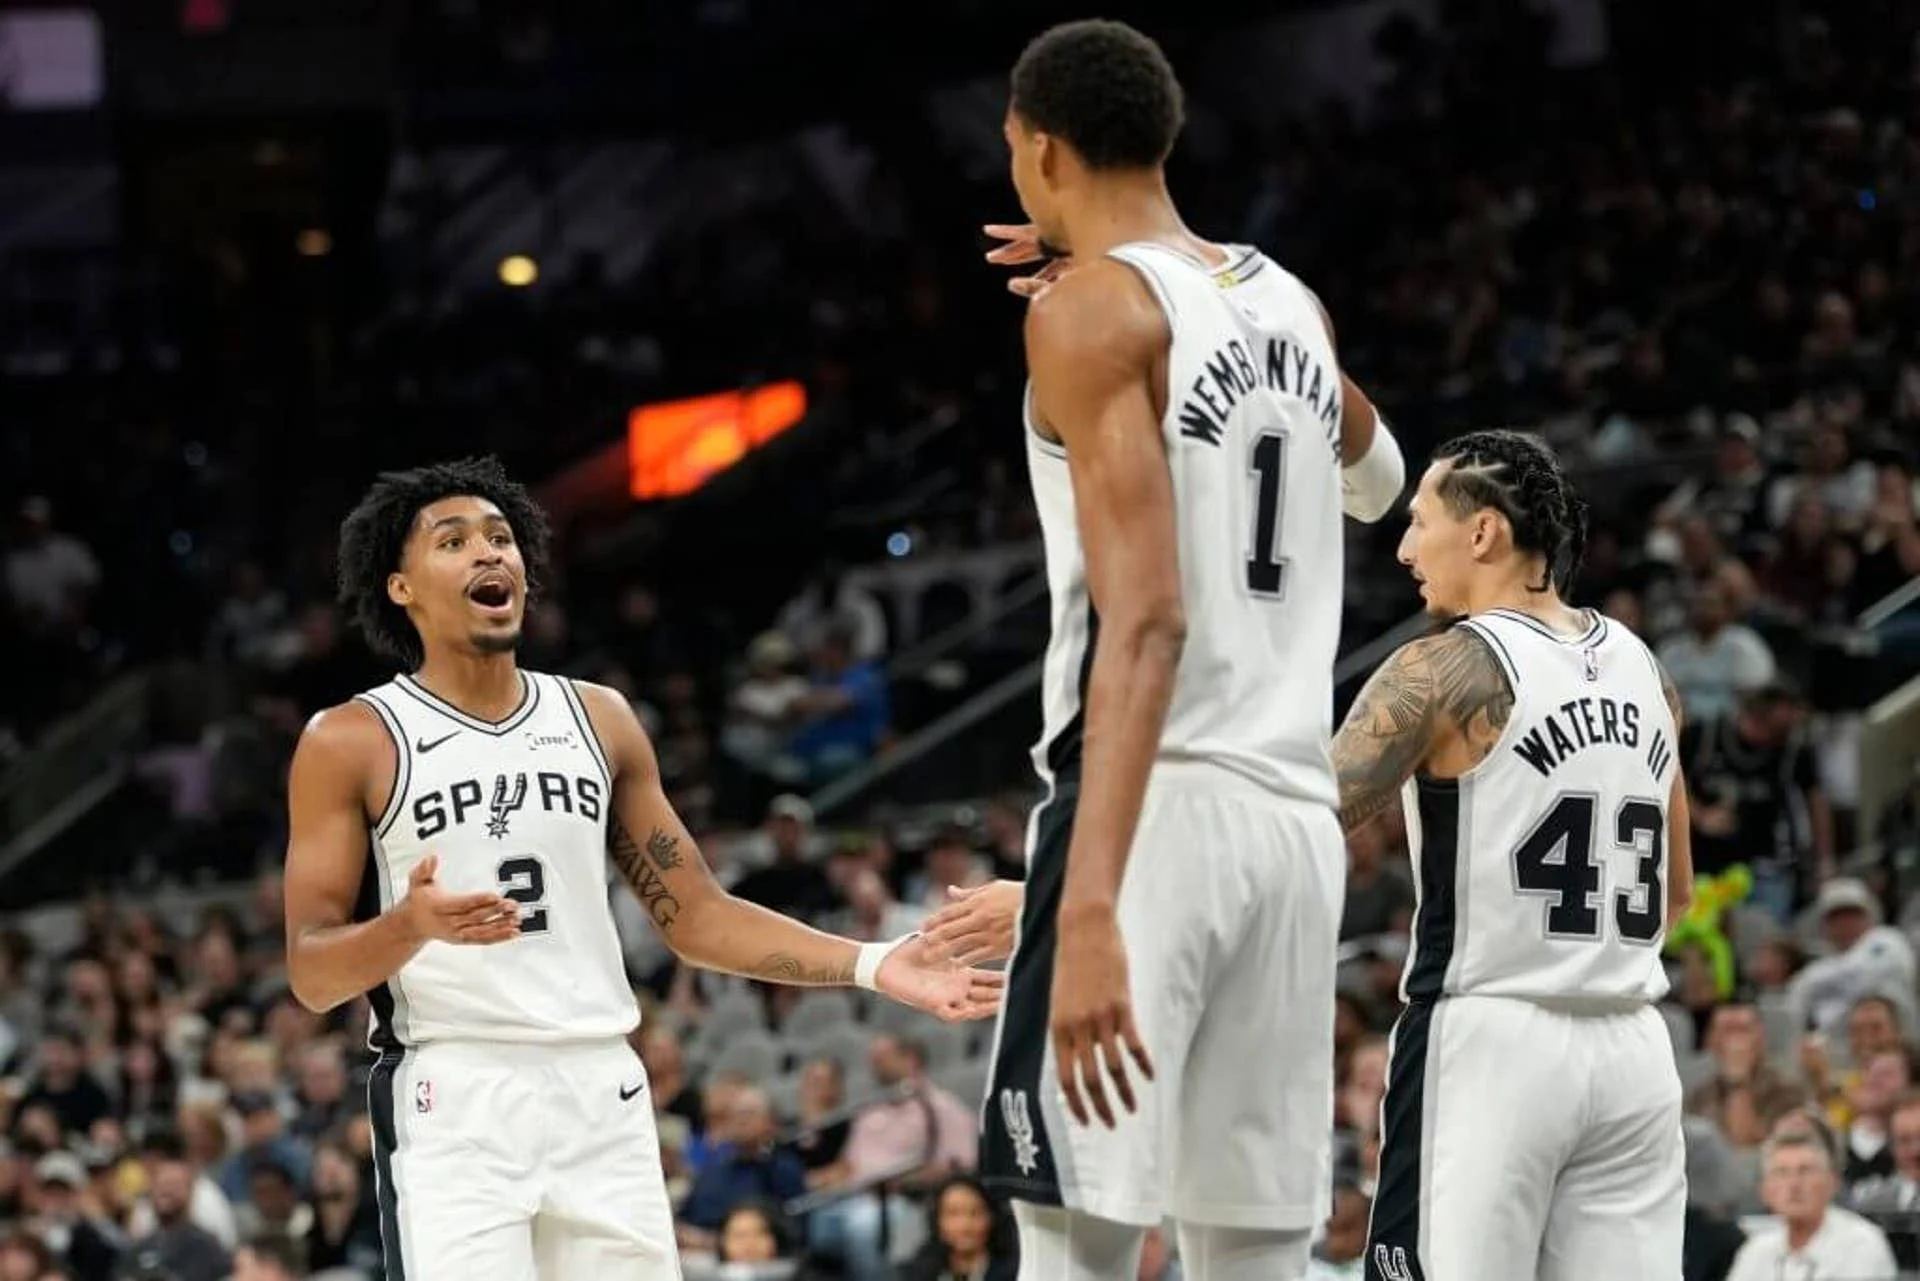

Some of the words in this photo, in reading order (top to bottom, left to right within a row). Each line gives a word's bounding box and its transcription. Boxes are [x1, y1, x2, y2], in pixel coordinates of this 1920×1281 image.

[1178, 338, 1341, 464] WEMBNYAM
[1246, 430, 1288, 600] 1
[1513, 696, 1639, 777] WATERS
[1647, 728, 1671, 781] III
[412, 772, 601, 841] SPURS
[496, 855, 551, 935] 2
[1512, 793, 1664, 944] 43
